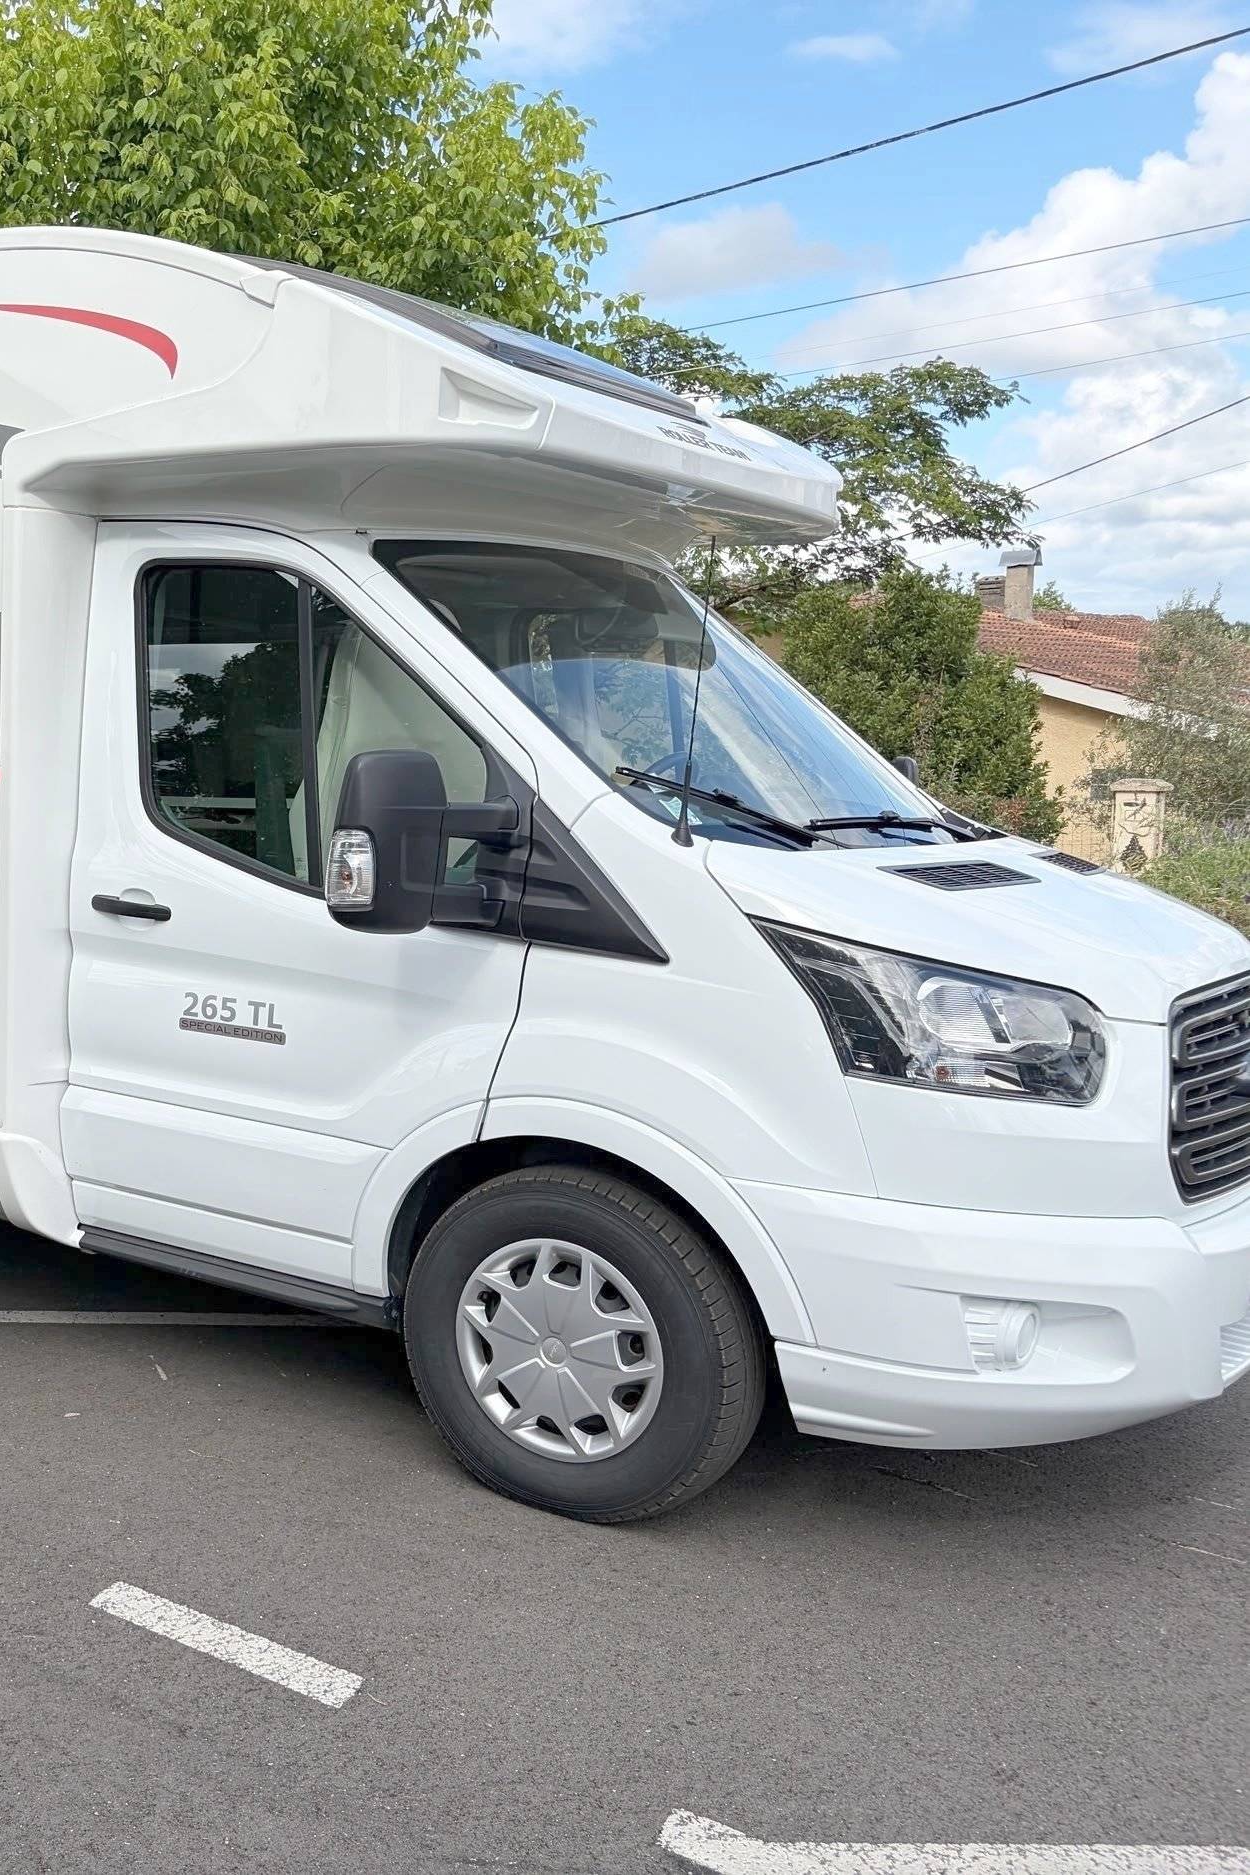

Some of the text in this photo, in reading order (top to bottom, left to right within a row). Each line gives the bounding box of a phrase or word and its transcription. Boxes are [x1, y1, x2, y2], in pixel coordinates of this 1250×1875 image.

[183, 991, 283, 1030] 265 TL
[180, 1019, 283, 1043] SPECIAL EDITION
